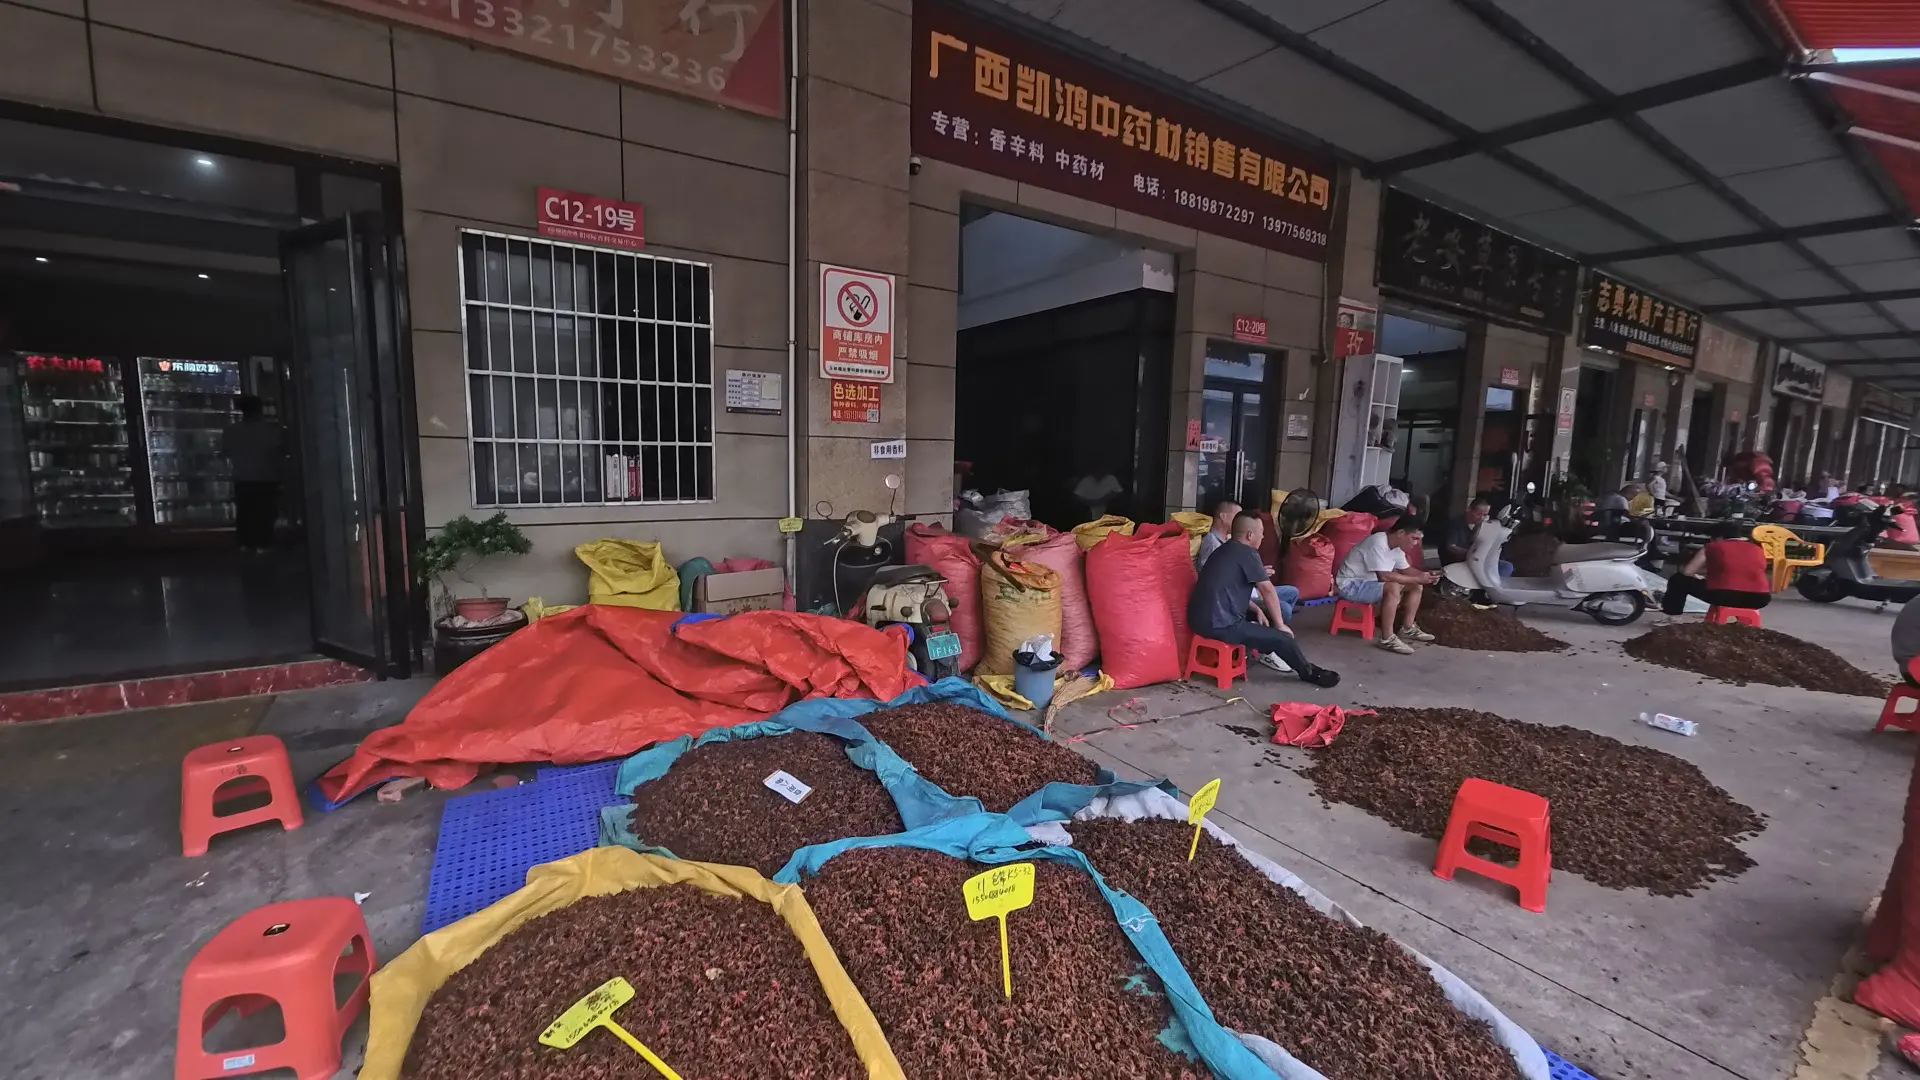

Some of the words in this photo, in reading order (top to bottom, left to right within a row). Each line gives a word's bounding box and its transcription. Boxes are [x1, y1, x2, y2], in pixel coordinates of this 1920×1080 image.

[448, 0, 727, 92] 13321753236
[929, 30, 1330, 211] 广西凯鸿中药材销售有限公司
[1055, 148, 1105, 181] 中药材
[1261, 215, 1327, 246] 13977569318
[545, 196, 637, 232] C12-19号
[1236, 318, 1266, 335] C12-20号
[832, 329, 883, 345] 商铺库房内
[837, 346, 879, 361] 严禁吸烟
[833, 382, 880, 402] 色选加工
[873, 444, 904, 455] 非食用香料
